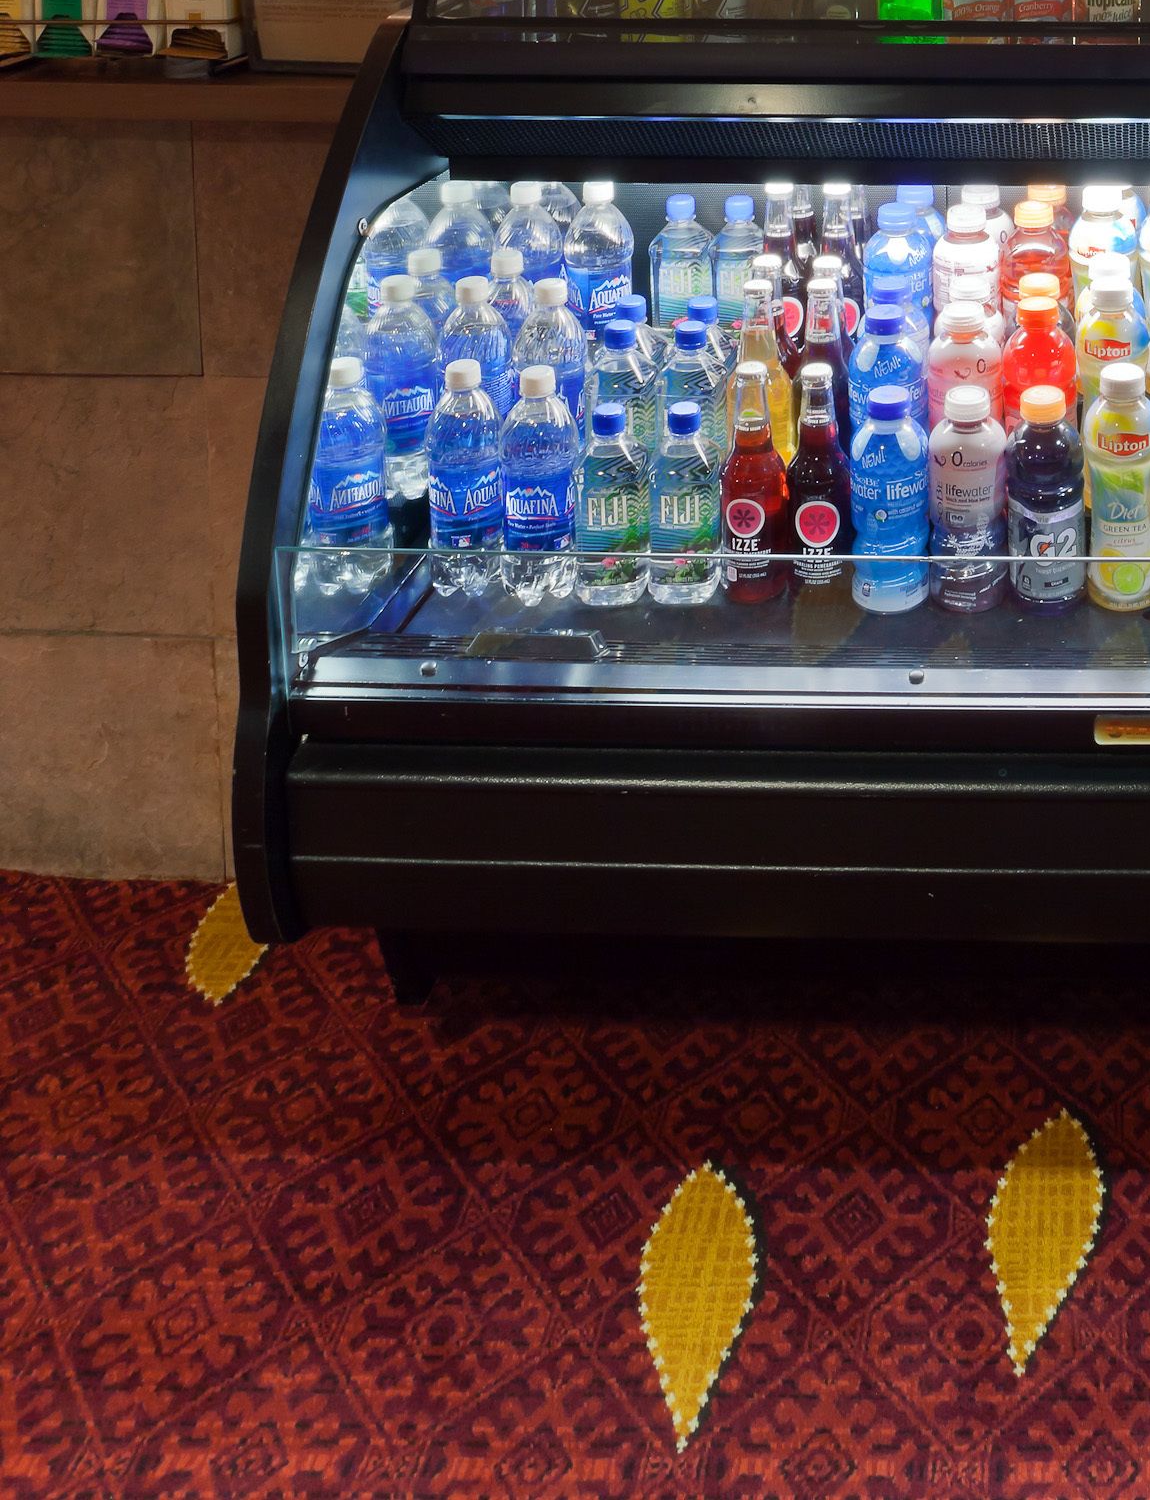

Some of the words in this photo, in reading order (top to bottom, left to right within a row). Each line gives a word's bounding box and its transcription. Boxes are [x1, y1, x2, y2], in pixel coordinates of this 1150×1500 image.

[954, 5, 974, 18] 100%
[1018, 2, 1054, 12] Cranberry
[660, 268, 691, 293] FIJI
[1085, 341, 1130, 358] Lipton
[1101, 436, 1147, 453] Lipton
[861, 449, 886, 469] NEW!
[952, 451, 962, 467] 0
[963, 459, 988, 467] calories
[945, 484, 993, 498] lifewater
[506, 495, 559, 518] AQUAFINA
[587, 497, 628, 526] FIJI
[660, 495, 699, 524] FIJI
[1108, 502, 1141, 519] Diet
[1103, 524, 1133, 533] GREEN
[1134, 523, 1147, 531] TEA
[732, 538, 759, 551] IZZE
[1030, 528, 1077, 567] G2
[1113, 537, 1136, 545] citrus
